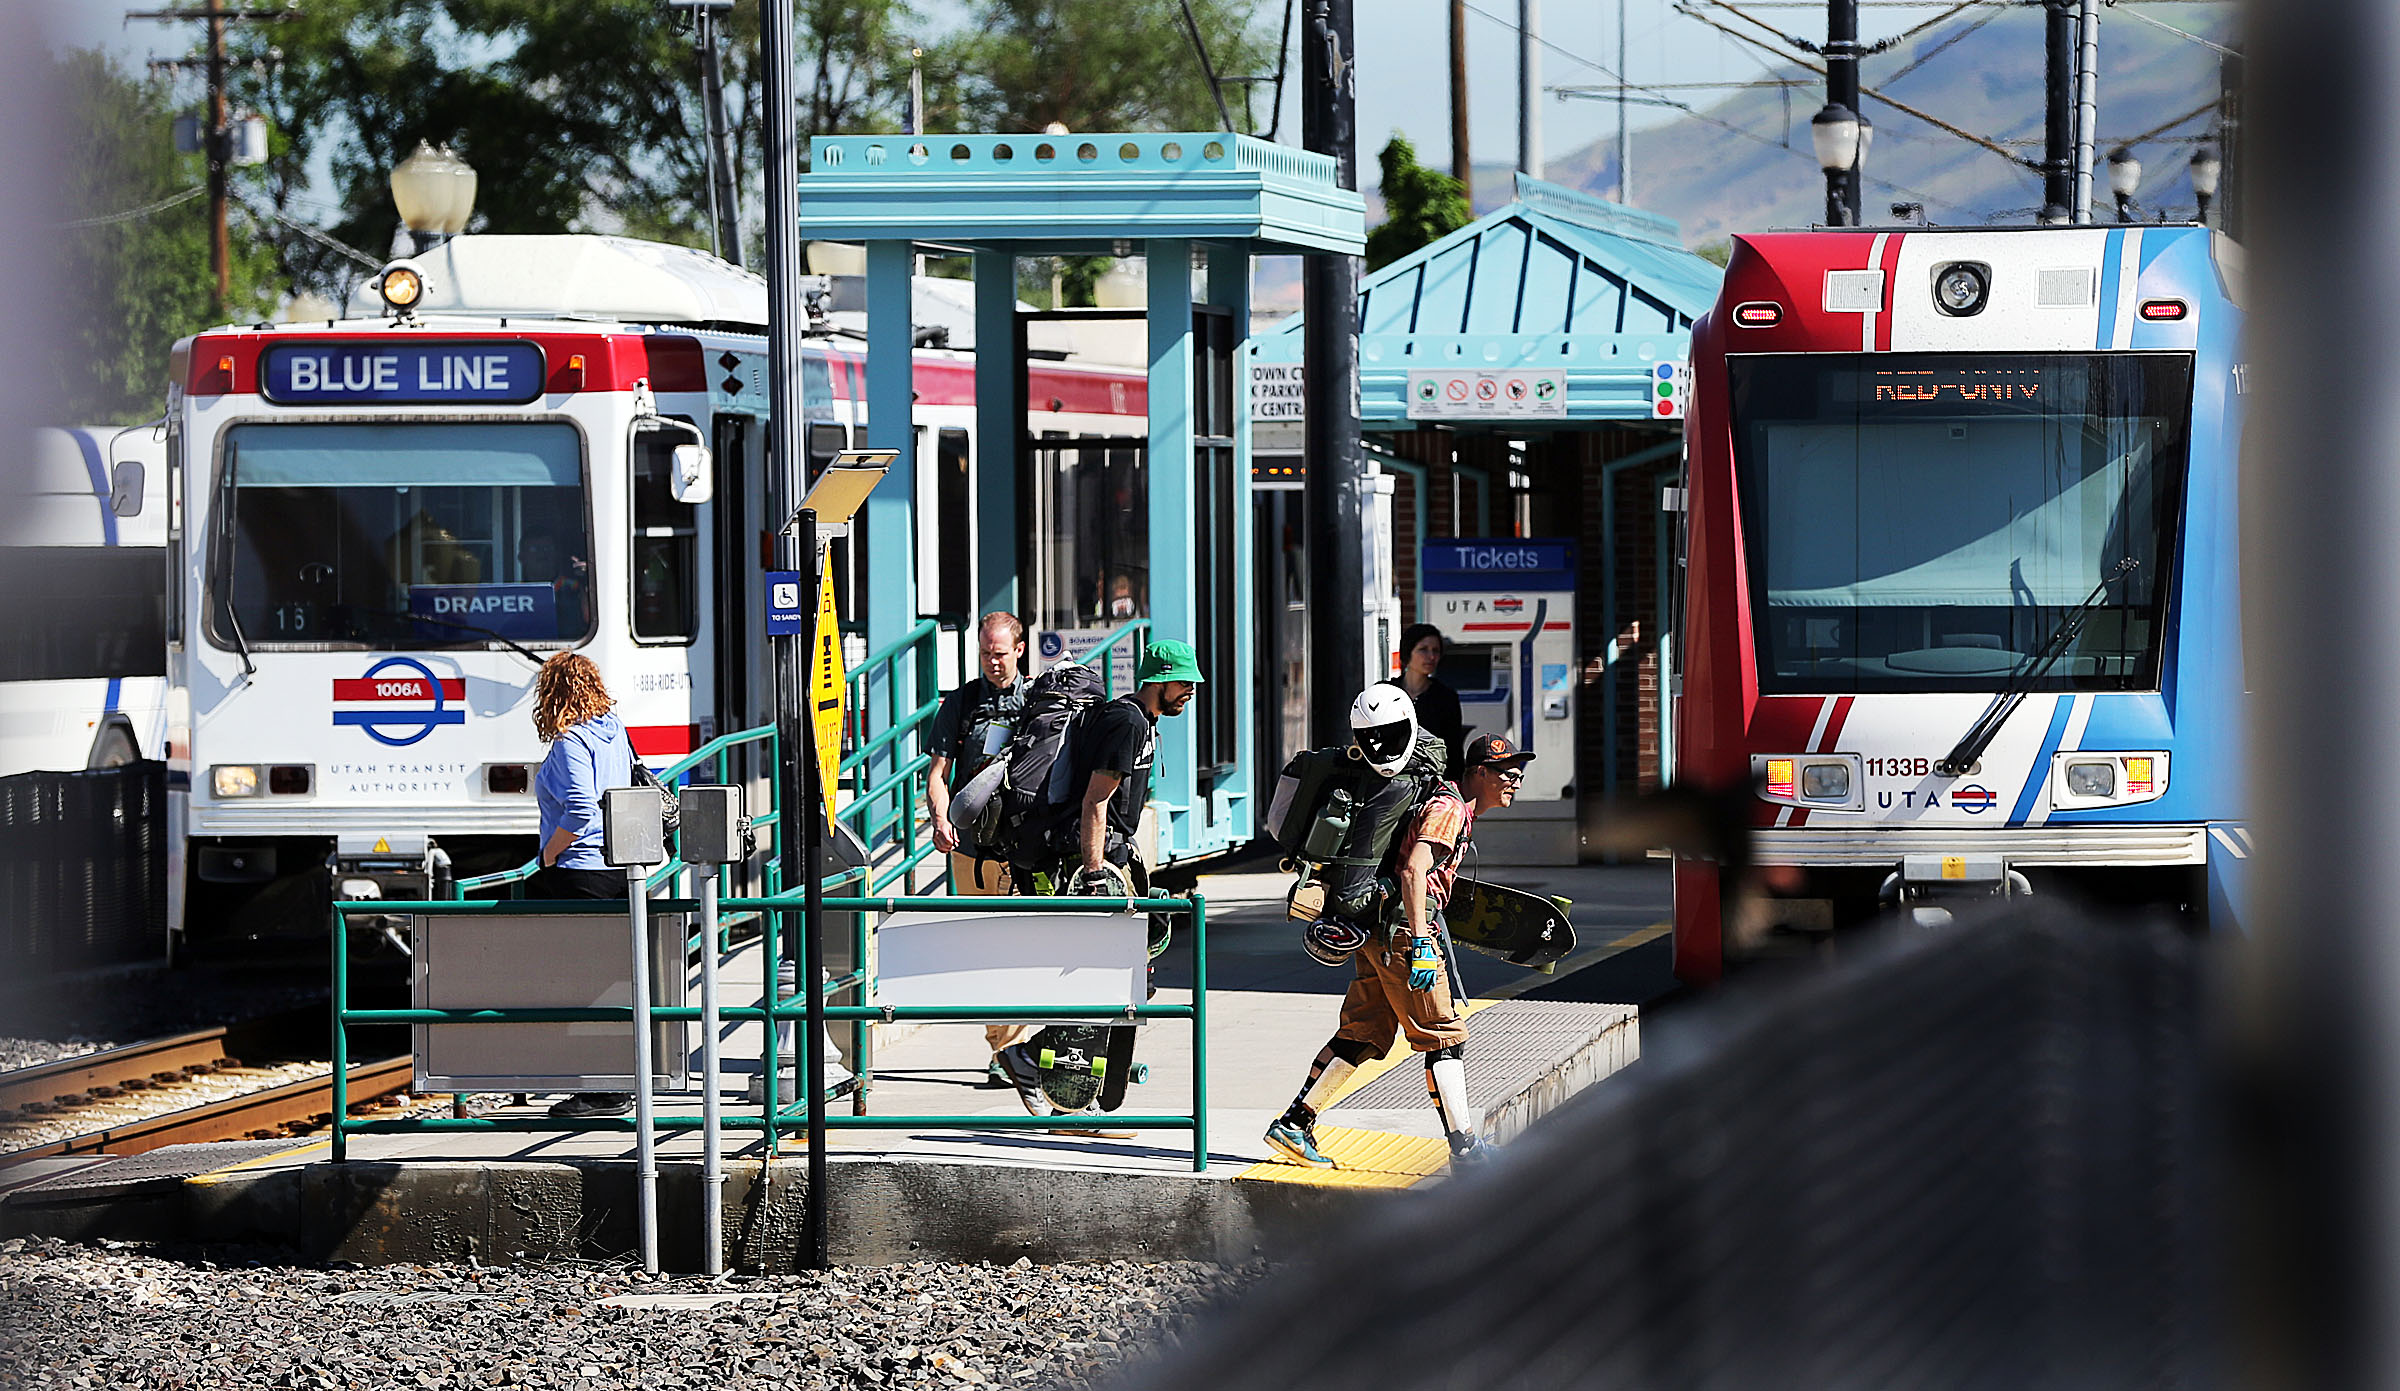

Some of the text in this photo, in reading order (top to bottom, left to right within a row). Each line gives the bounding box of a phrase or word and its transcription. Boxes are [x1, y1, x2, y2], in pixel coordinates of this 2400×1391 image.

[290, 355, 510, 392] BLUE LINE
[1261, 403, 1305, 416] CENTR
[1456, 547, 1538, 569] Tickets
[433, 595, 535, 614] DRAPER
[1446, 600, 1487, 614] UTA
[771, 613, 781, 622] TO
[375, 682, 423, 697] 1006A
[330, 763, 467, 774] UTAH TRANSIT
[1866, 757, 1929, 777] 1133B
[349, 781, 451, 793] AUTHORITY
[1878, 790, 1941, 809] UTA
